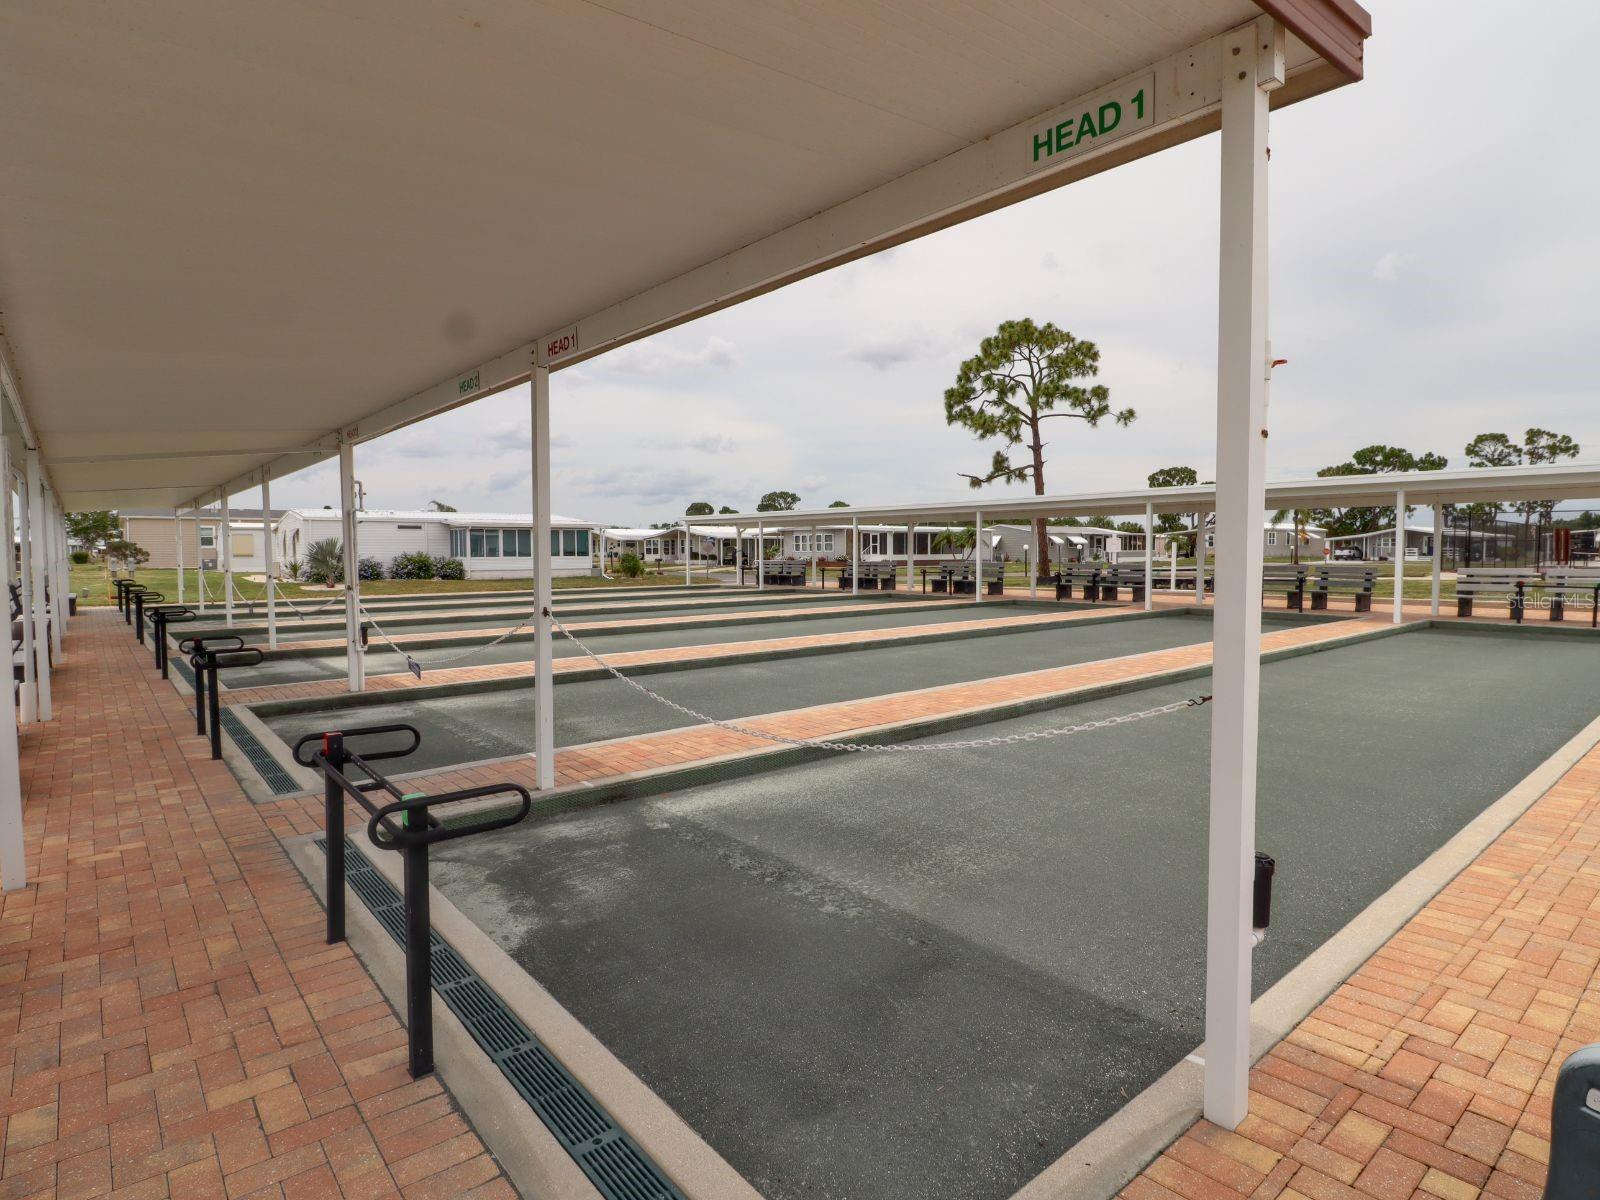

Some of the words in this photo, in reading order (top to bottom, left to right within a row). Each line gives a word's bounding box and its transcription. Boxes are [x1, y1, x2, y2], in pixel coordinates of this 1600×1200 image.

[1033, 101, 1122, 162] HEAD
[1131, 88, 1144, 120] 1
[547, 336, 570, 357] HEAD
[570, 333, 575, 347] 1
